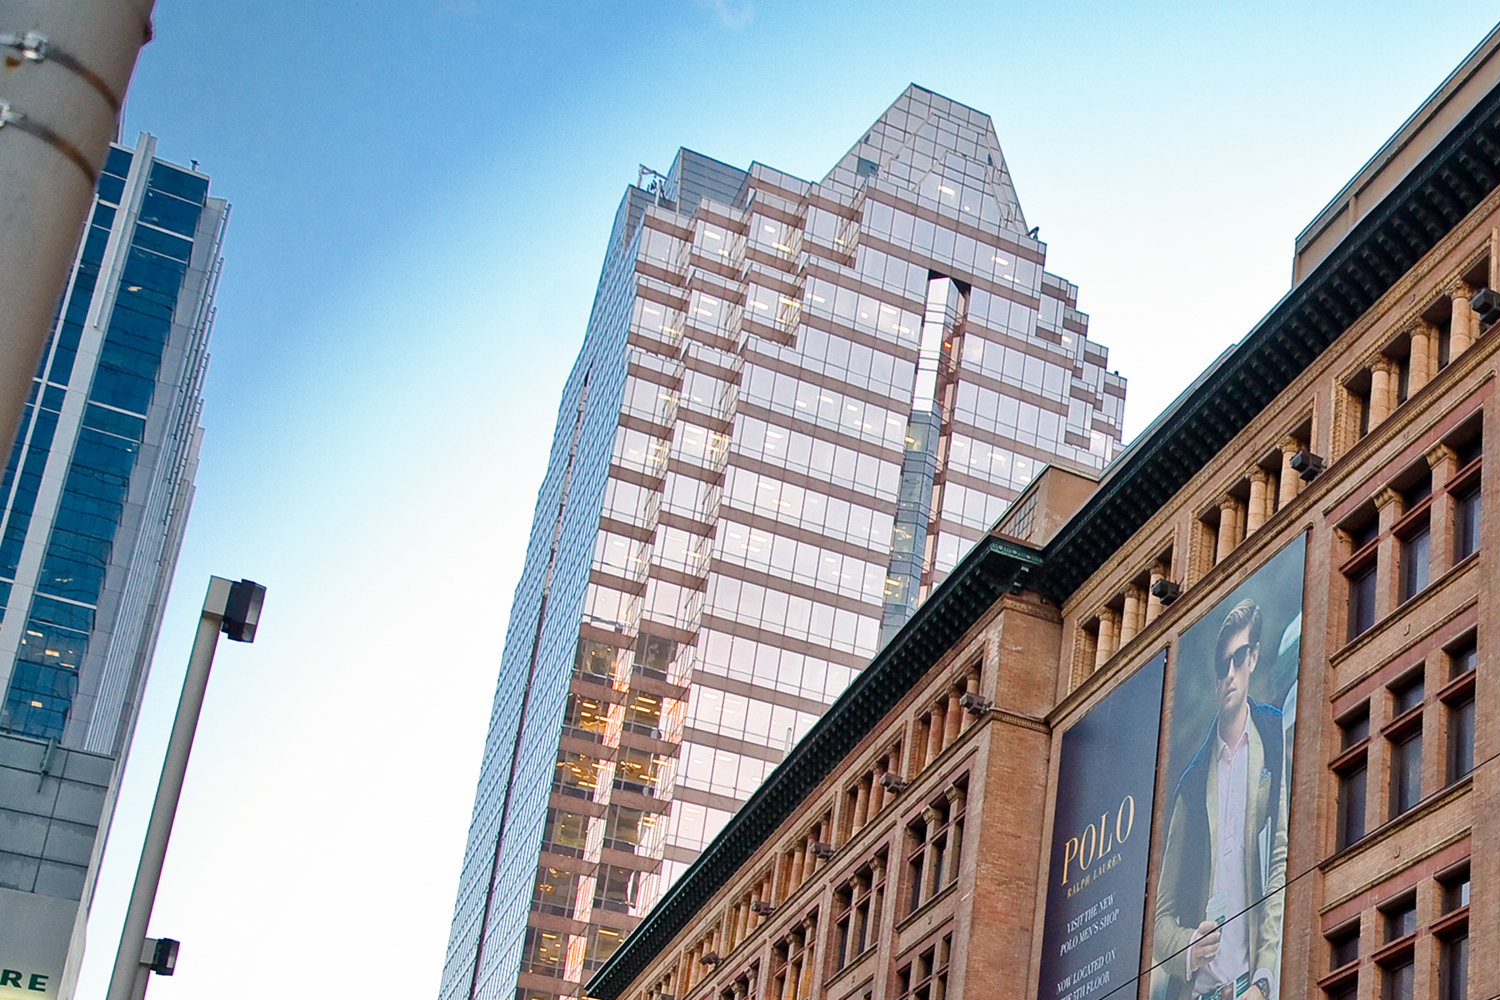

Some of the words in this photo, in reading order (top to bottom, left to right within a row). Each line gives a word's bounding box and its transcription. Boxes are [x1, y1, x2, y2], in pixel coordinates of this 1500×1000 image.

[1061, 795, 1135, 886] POLO
[1067, 874, 1091, 899] RALPH
[1093, 851, 1122, 880] LAUREN
[1060, 935, 1079, 957] POLO
[1078, 920, 1099, 945] MEN'S
[1099, 908, 1120, 931] SHOP
[1067, 913, 1085, 934] VISIT
[1084, 903, 1099, 922] THE
[1098, 891, 1116, 914] NEW
[1056, 974, 1073, 996] NOW
[1072, 955, 1105, 985] LOCATED
[1105, 947, 1117, 964] ON
[1086, 970, 1110, 995] FLOOR
